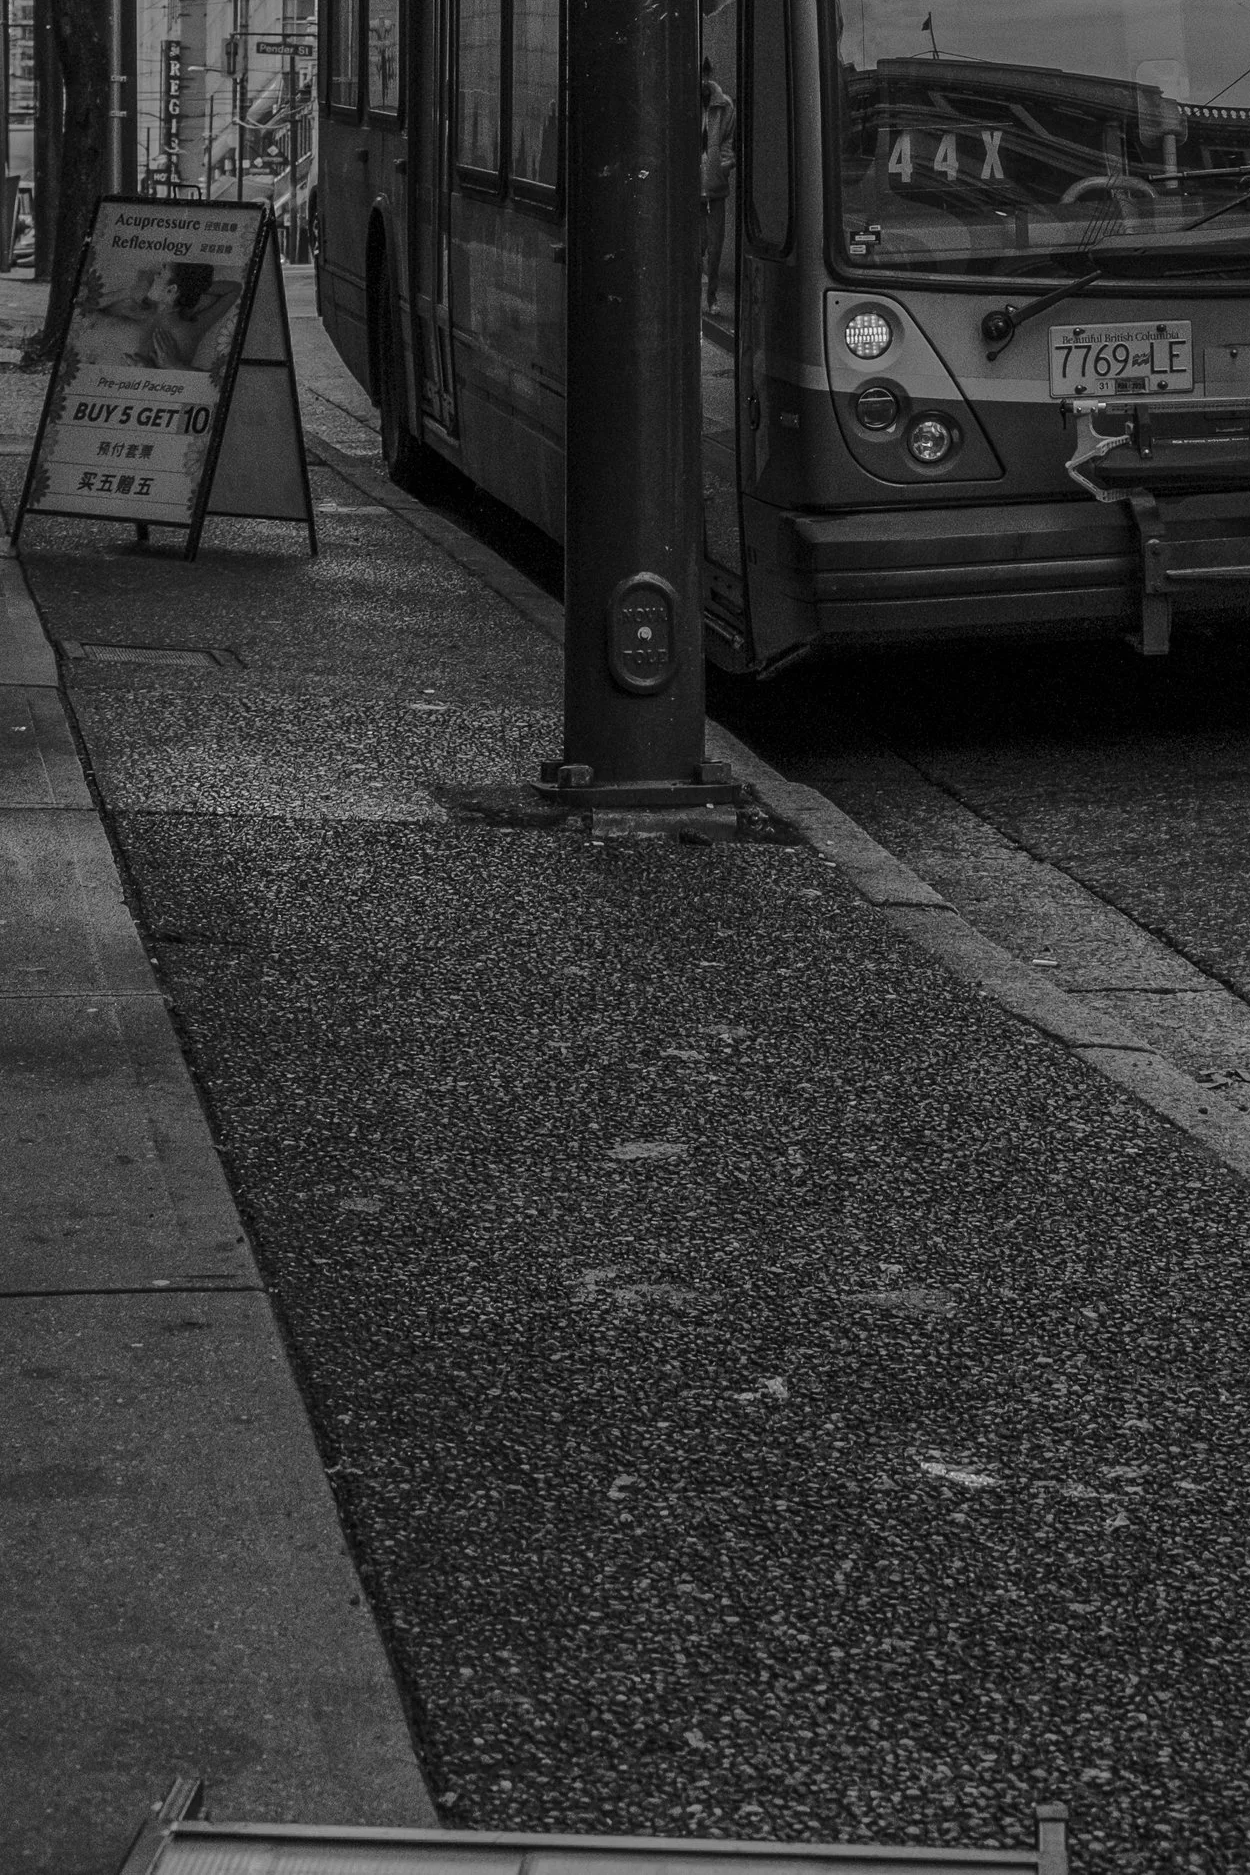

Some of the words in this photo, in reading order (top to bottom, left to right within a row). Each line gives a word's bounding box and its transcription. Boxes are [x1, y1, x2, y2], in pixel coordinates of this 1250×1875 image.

[259, 43, 294, 54] Pender
[115, 213, 201, 230] Acupressure
[111, 235, 193, 256] Reflexology
[1062, 333, 1103, 345] Beautiful
[1104, 332, 1135, 343] British
[1135, 330, 1180, 342] Columbia
[1054, 343, 1130, 378] 7769
[1149, 340, 1188, 375] LE
[97, 377, 142, 391] Pre-paid
[142, 380, 185, 396] Package
[1099, 381, 1110, 390] 31
[73, 402, 118, 424] BUY
[118, 406, 134, 425] 5
[136, 407, 180, 428] GET
[183, 405, 211, 434] 10
[97, 441, 154, 460] 预付套票
[77, 471, 154, 496] 买五赠五
